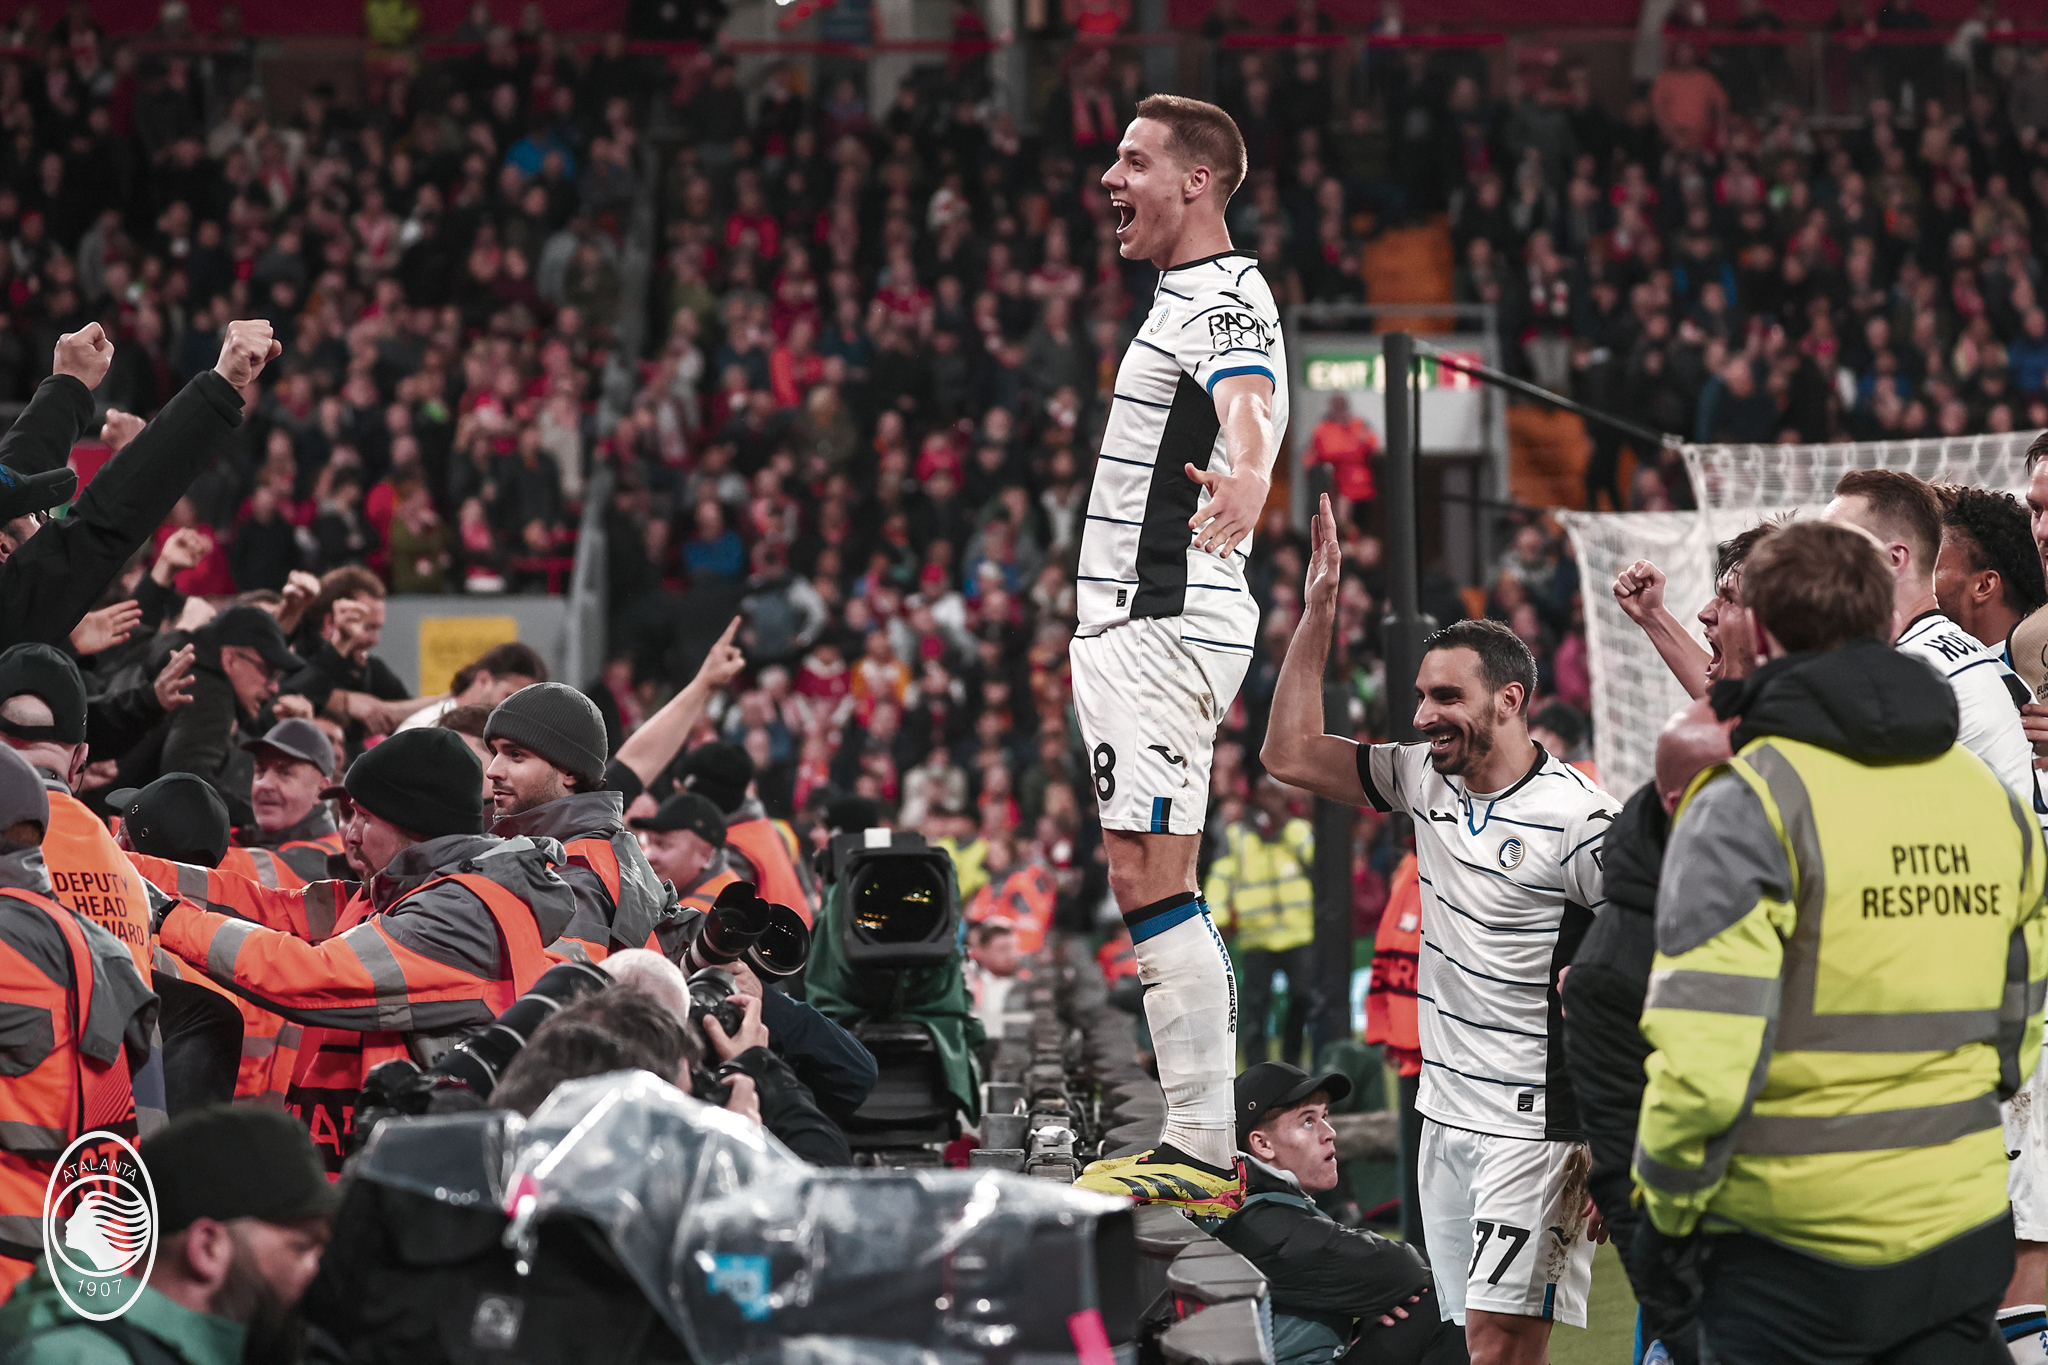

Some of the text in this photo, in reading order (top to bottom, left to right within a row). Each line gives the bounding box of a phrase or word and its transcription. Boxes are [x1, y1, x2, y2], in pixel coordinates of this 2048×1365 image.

[1093, 742, 1117, 802] 8
[1891, 843, 1971, 876] PITCH
[52, 871, 129, 895] DEPUTY
[72, 895, 128, 918] HEAD
[1862, 883, 2001, 920] RESPONSE
[1468, 1220, 1531, 1286] 77
